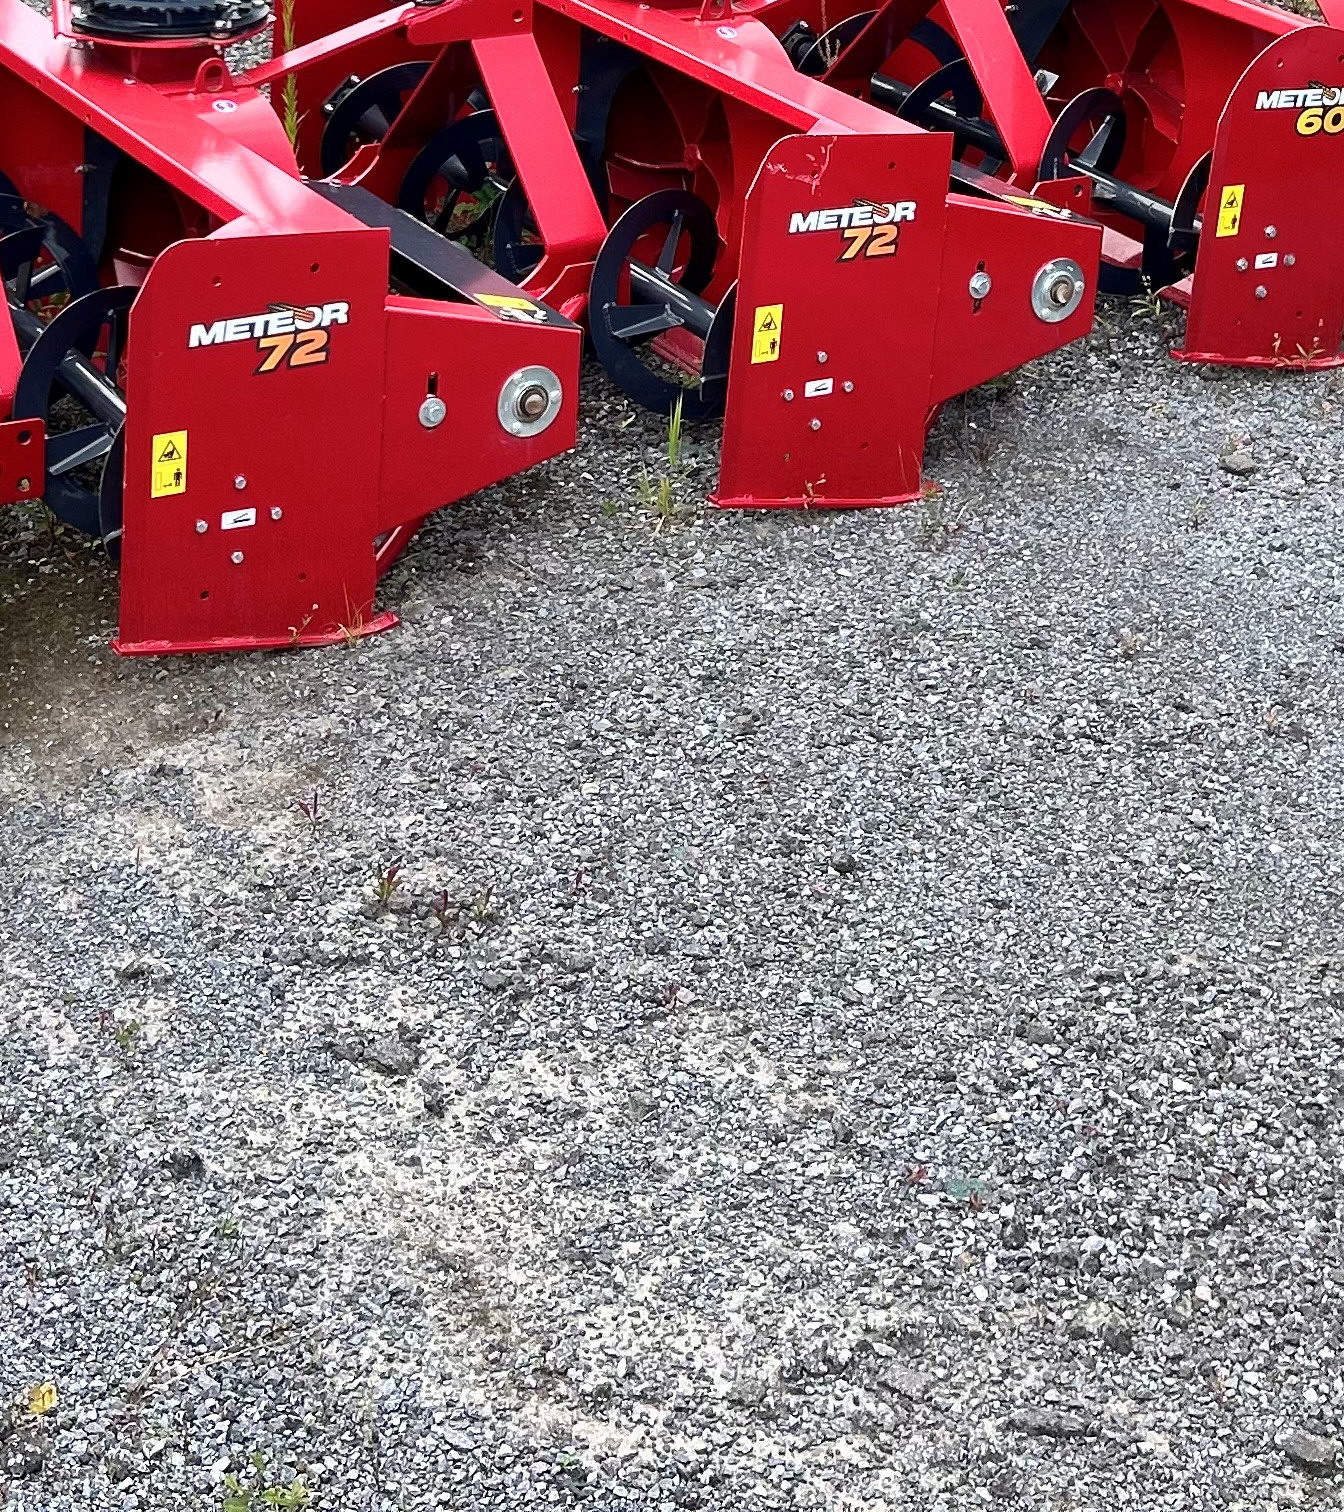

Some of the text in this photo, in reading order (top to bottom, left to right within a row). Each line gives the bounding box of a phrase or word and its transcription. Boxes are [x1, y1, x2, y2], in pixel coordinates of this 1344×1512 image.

[788, 199, 917, 235] METEOR
[839, 224, 899, 262] 72
[187, 300, 350, 349] METEOR
[256, 330, 329, 373] 72
